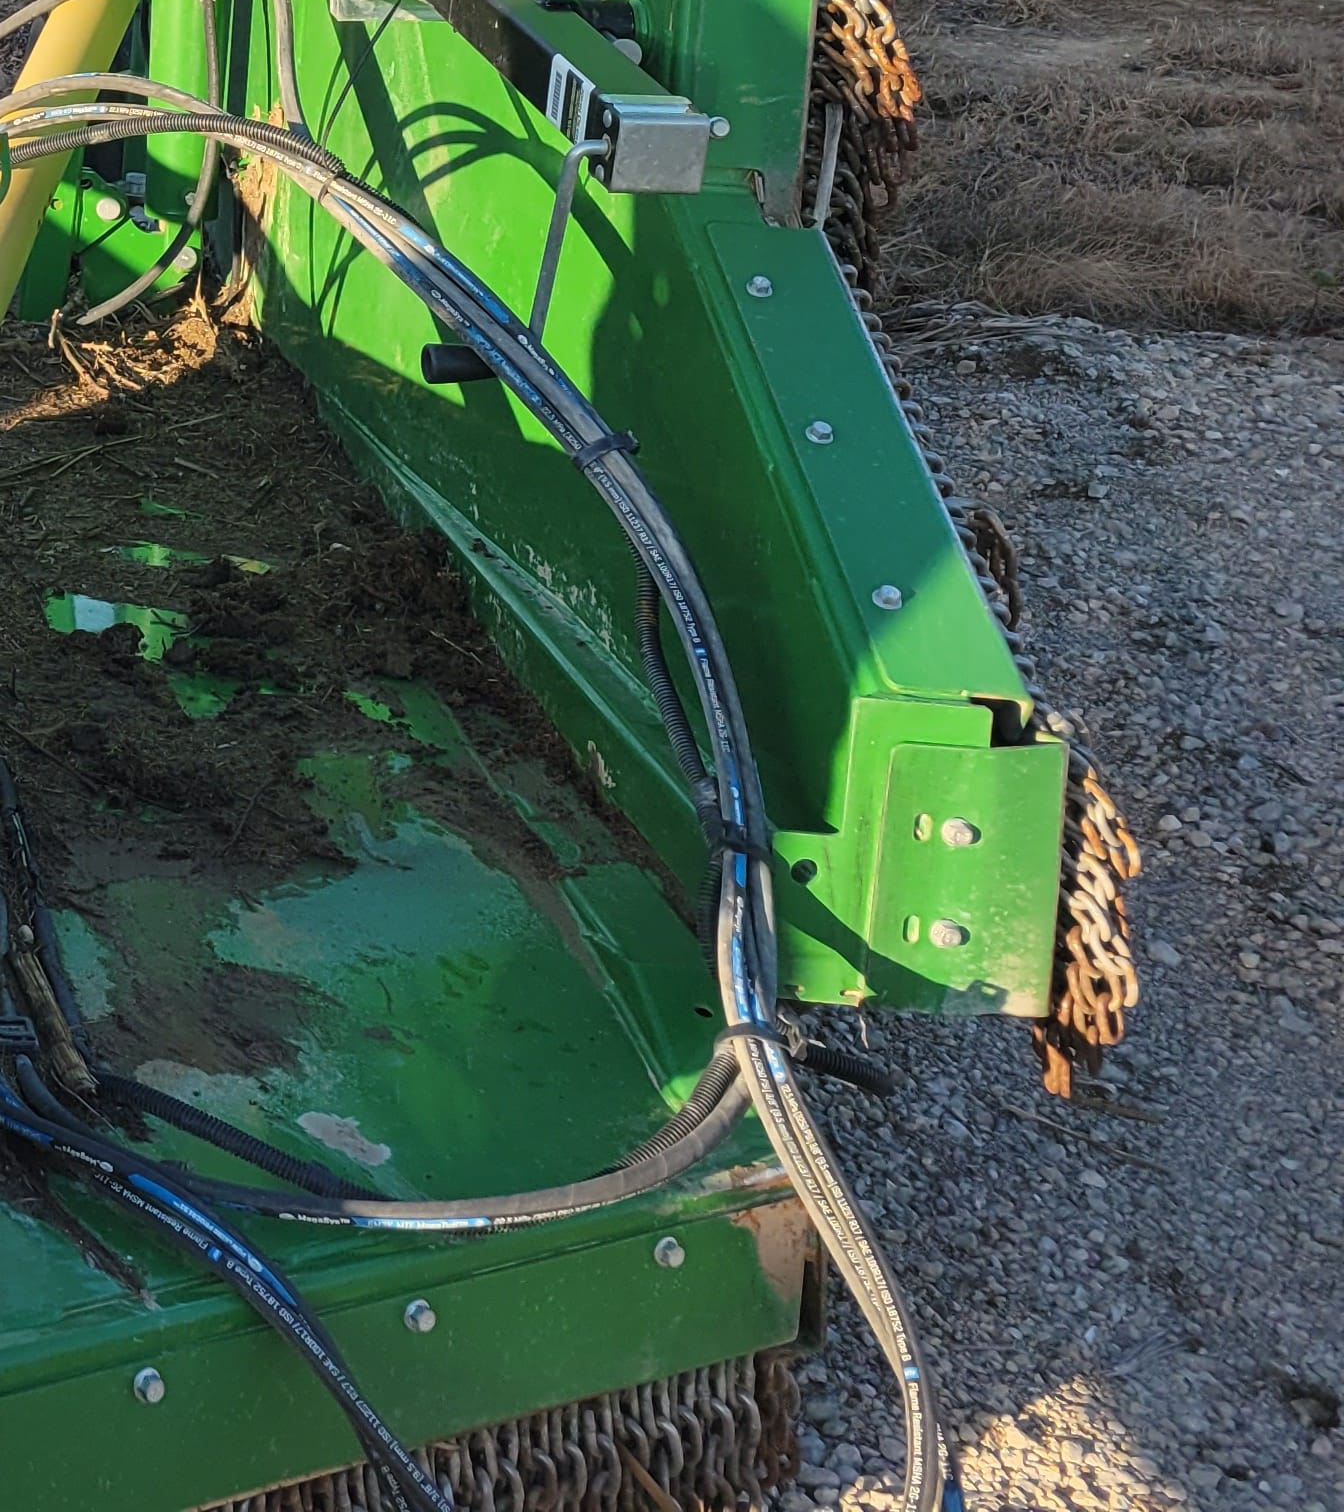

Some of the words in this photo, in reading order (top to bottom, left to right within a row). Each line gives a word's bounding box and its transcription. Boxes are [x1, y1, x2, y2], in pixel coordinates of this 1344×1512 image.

[123, 1189, 145, 1210] MSHA
[145, 1203, 181, 1233] Resistant
[182, 1228, 208, 1251] Flame
[226, 1260, 233, 1269] B
[234, 1265, 253, 1285] Type
[253, 1283, 280, 1311] 18752
[858, 1239, 873, 1256] SAE
[886, 1304, 904, 1334] 18752
[896, 1332, 909, 1355] Type
[279, 1307, 295, 1325] ISO
[323, 1356, 340, 1377] SAE
[341, 1382, 359, 1400] R17
[908, 1382, 920, 1411] Flame
[377, 1425, 394, 1445] ISO
[912, 1412, 923, 1457] Resistant
[912, 1456, 924, 1485] MSHA
